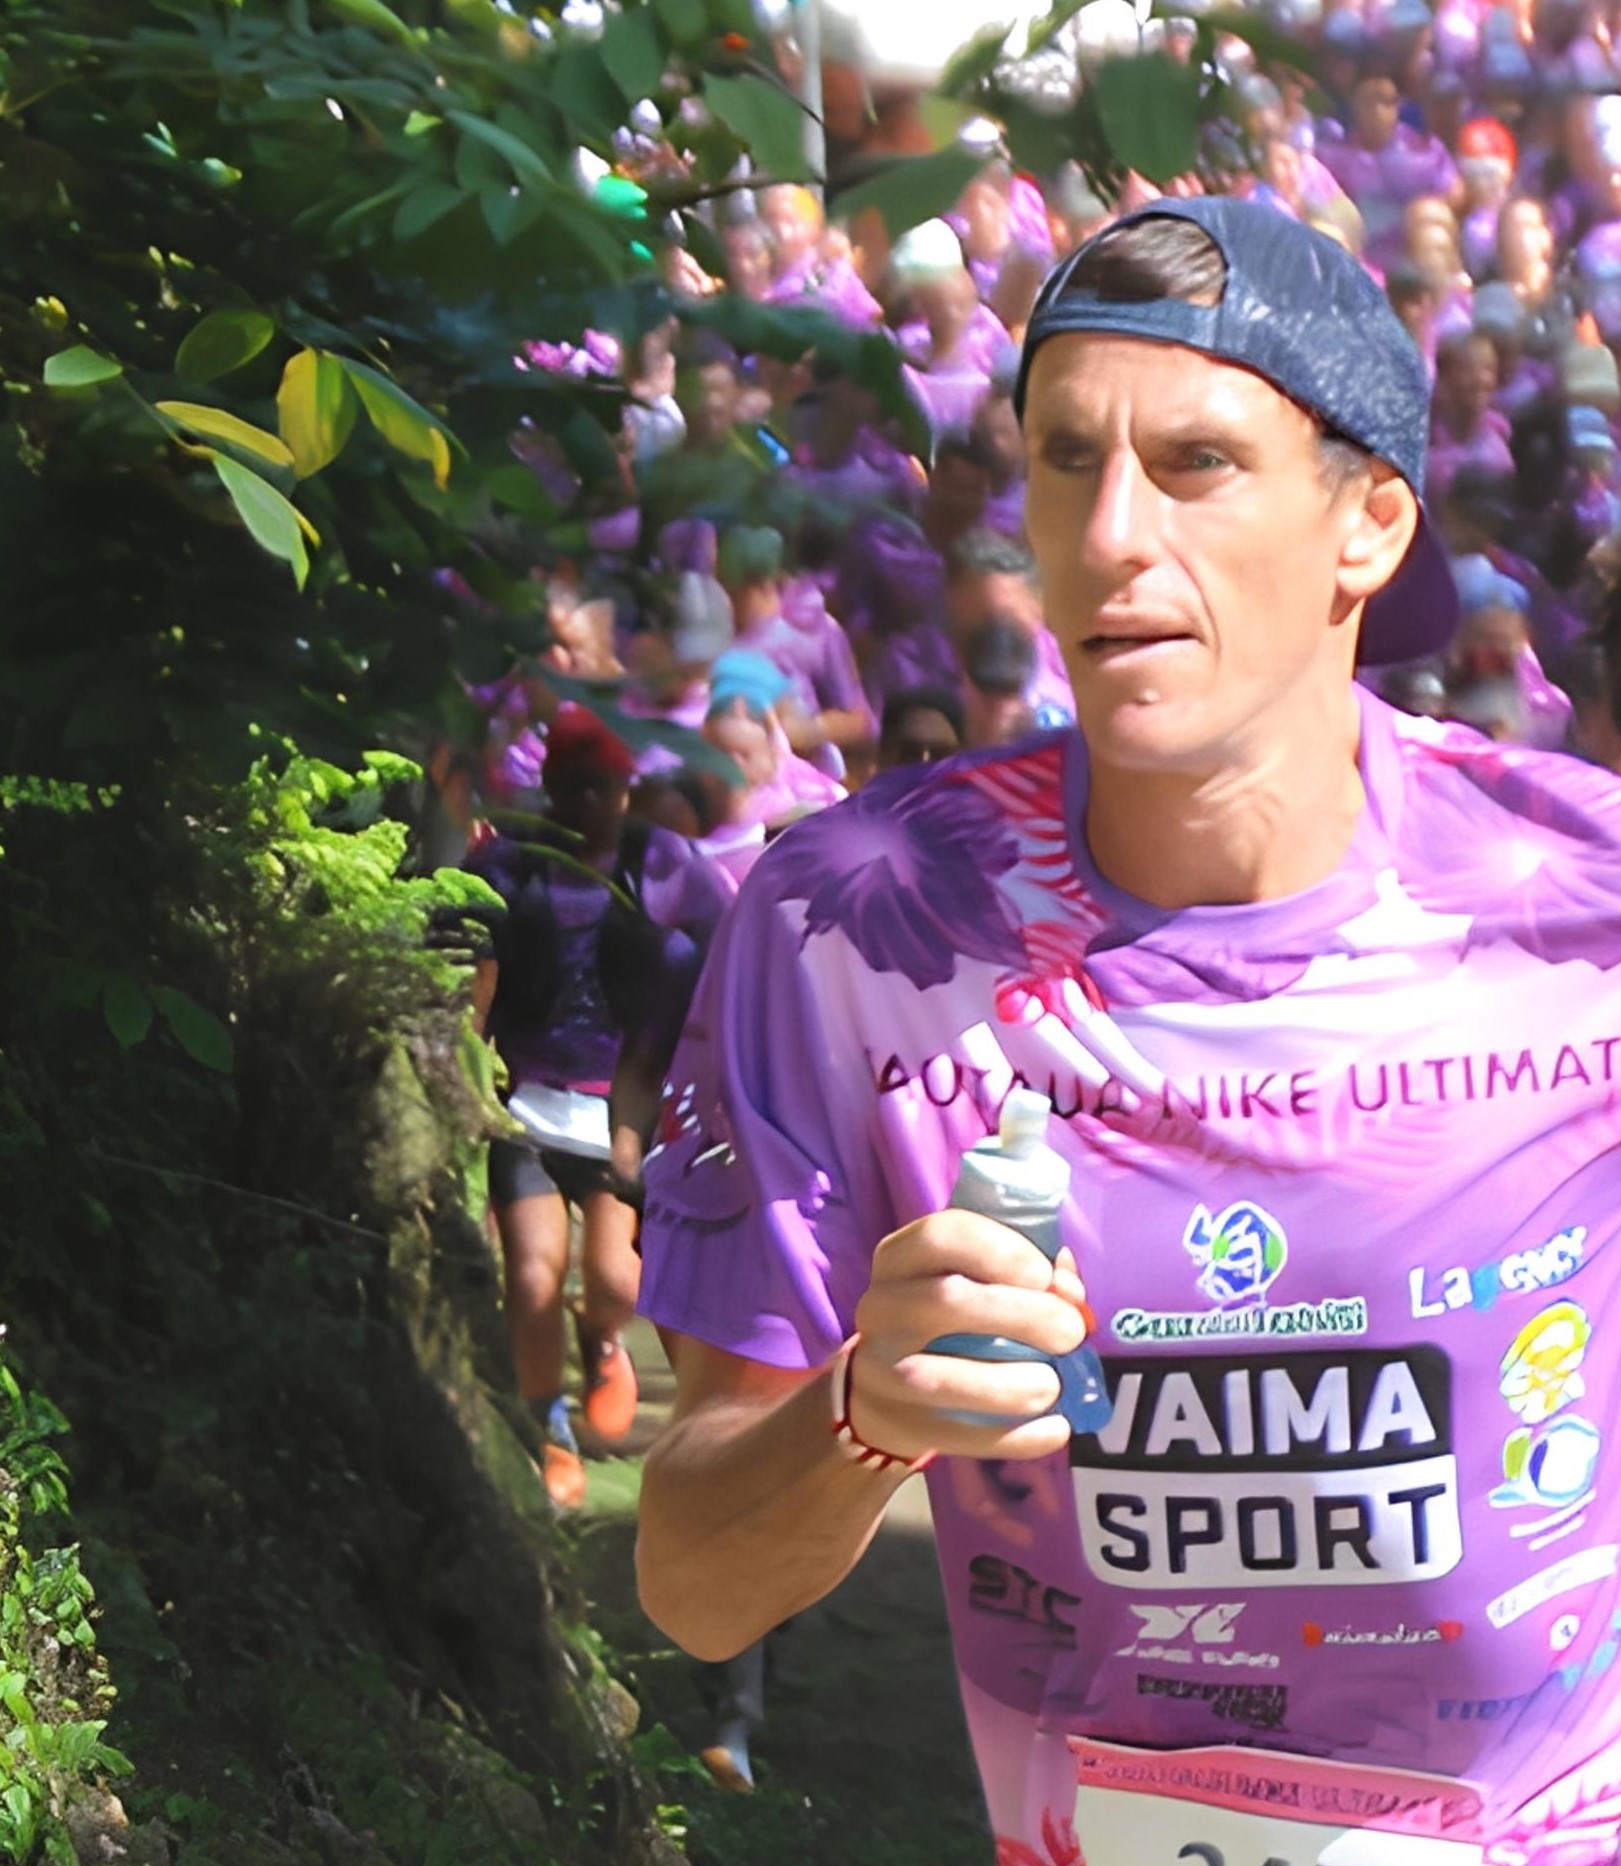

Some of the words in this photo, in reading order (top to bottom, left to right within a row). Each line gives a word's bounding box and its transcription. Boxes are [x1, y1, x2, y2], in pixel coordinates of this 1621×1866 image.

[1162, 1071, 1317, 1119] NIKE
[1097, 1361, 1437, 1455] VAIMA
[1096, 1483, 1447, 1573] SPORT
